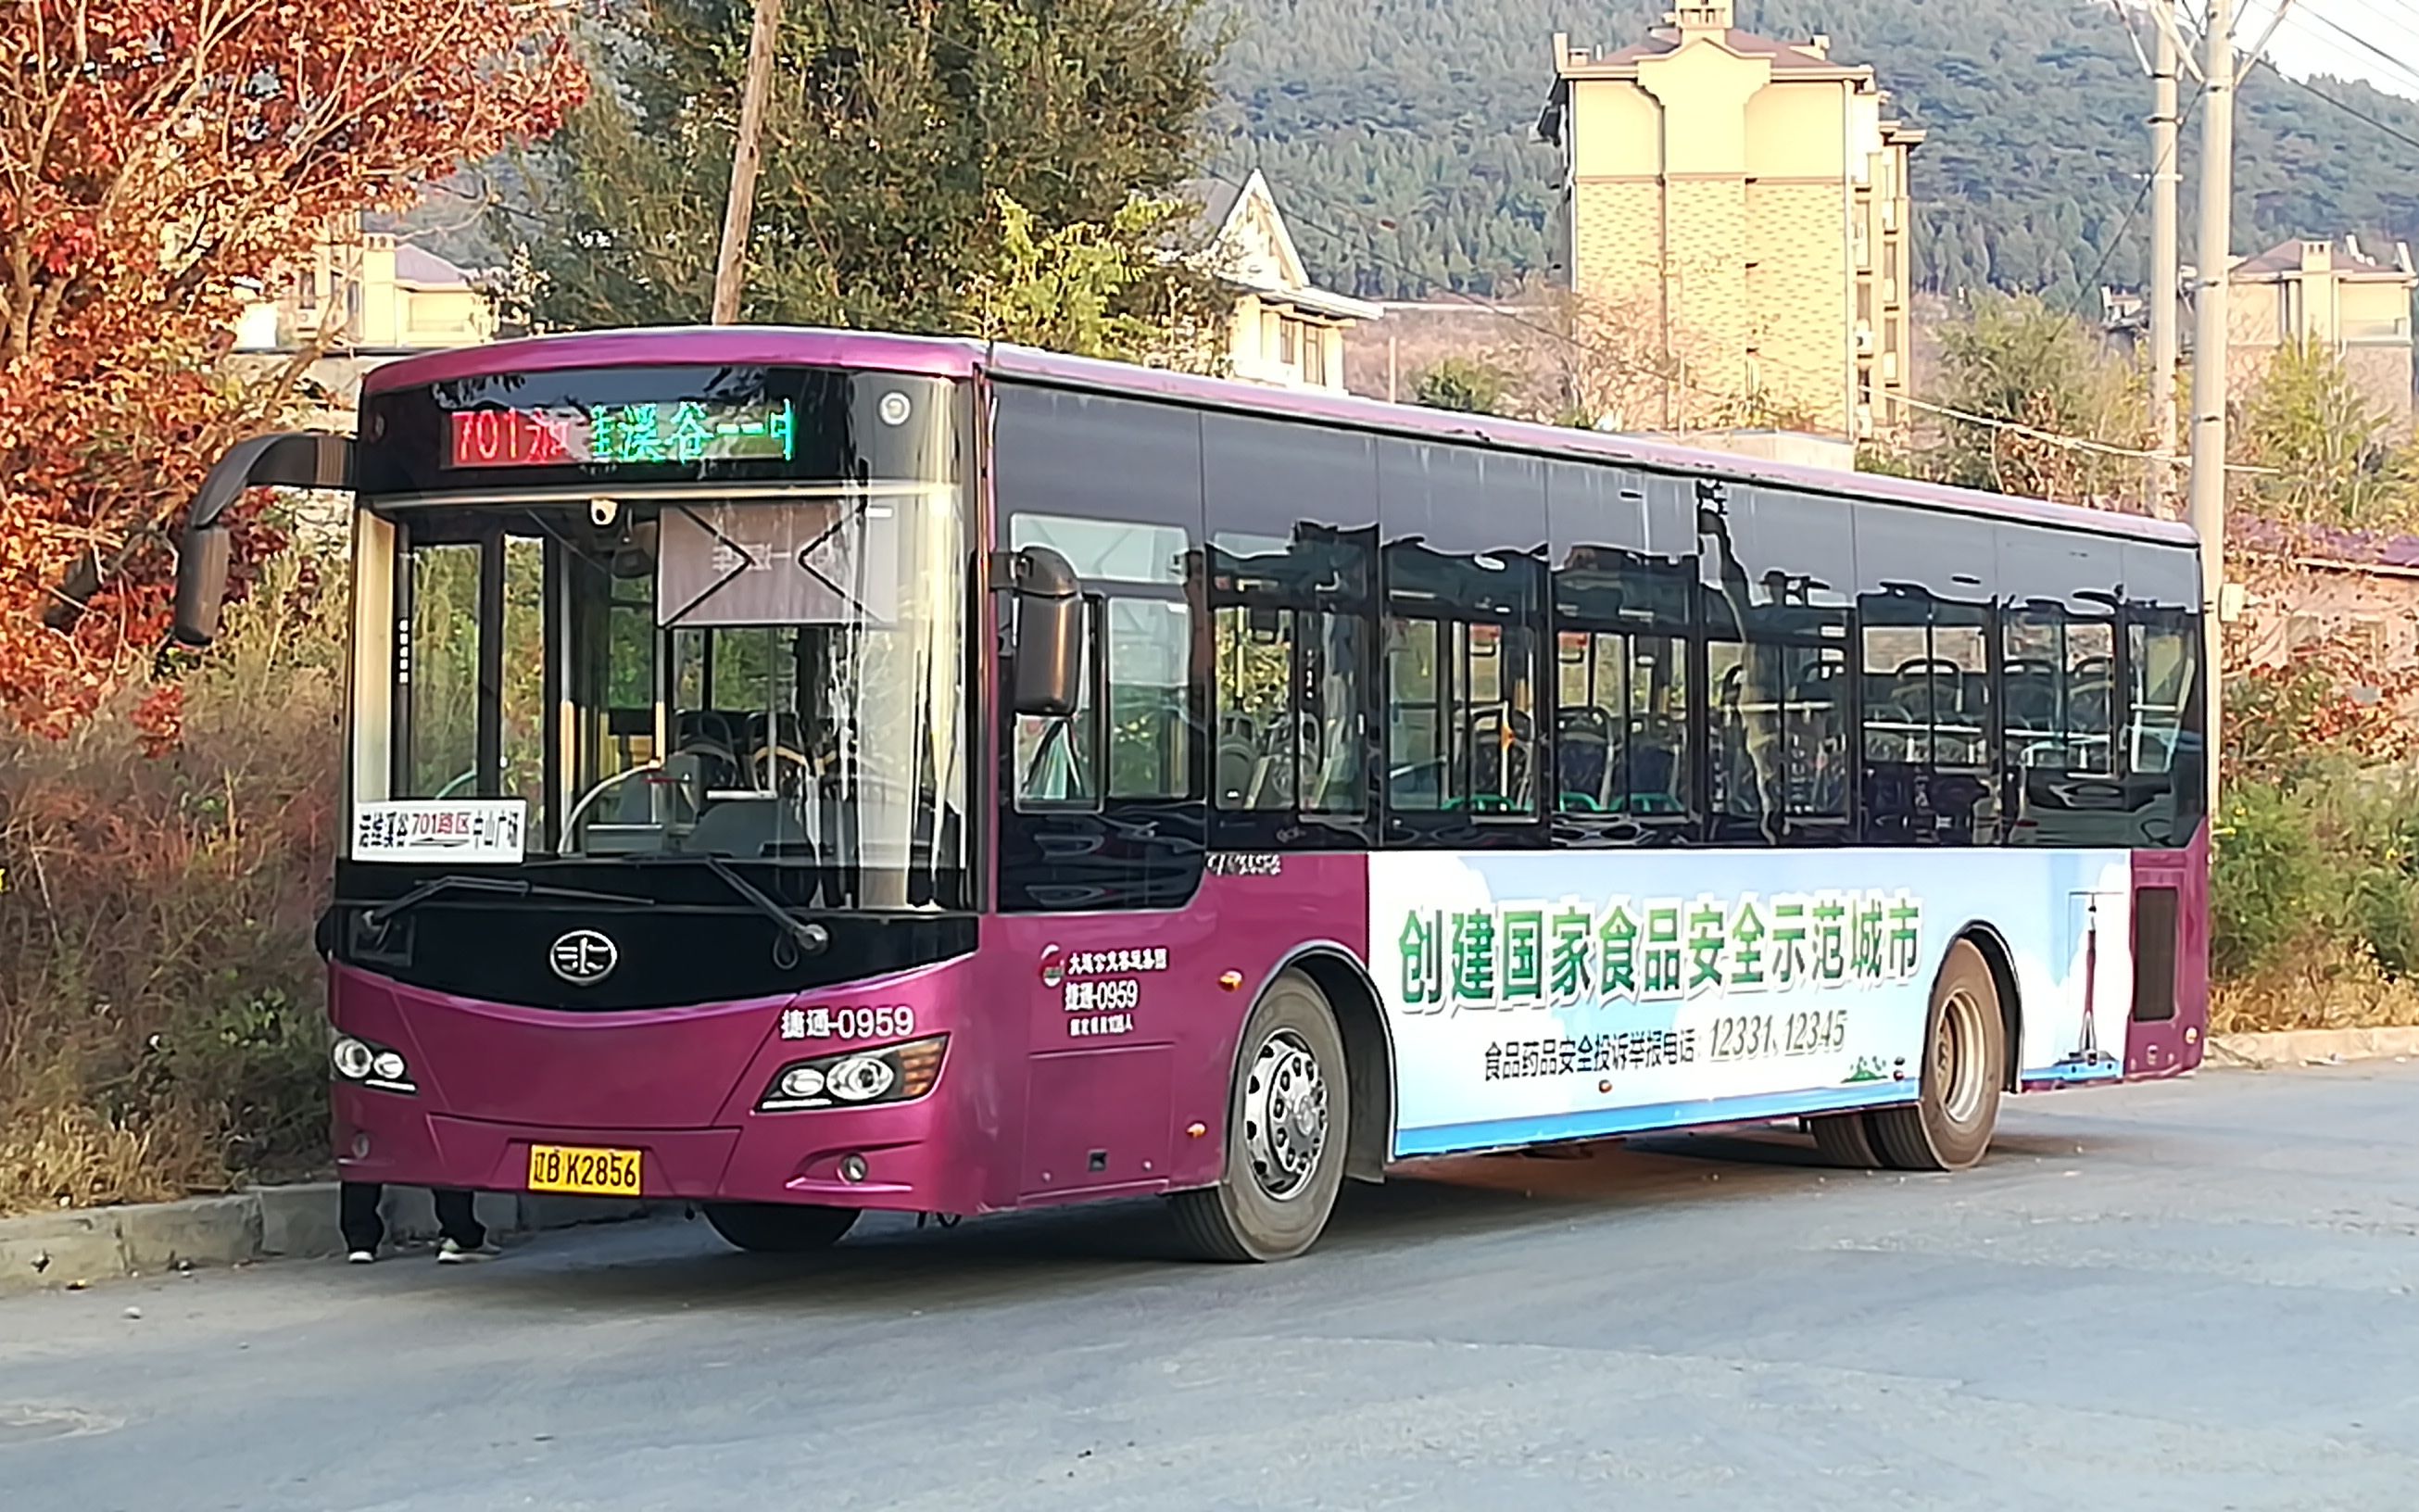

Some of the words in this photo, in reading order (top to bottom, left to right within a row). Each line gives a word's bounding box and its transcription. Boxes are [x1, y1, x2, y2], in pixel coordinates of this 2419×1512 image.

[1397, 897, 1921, 1005] 创建国家食品安全示范城市
[780, 1005, 914, 1040] 捷通-0959
[566, 1153, 636, 1188] K2856
